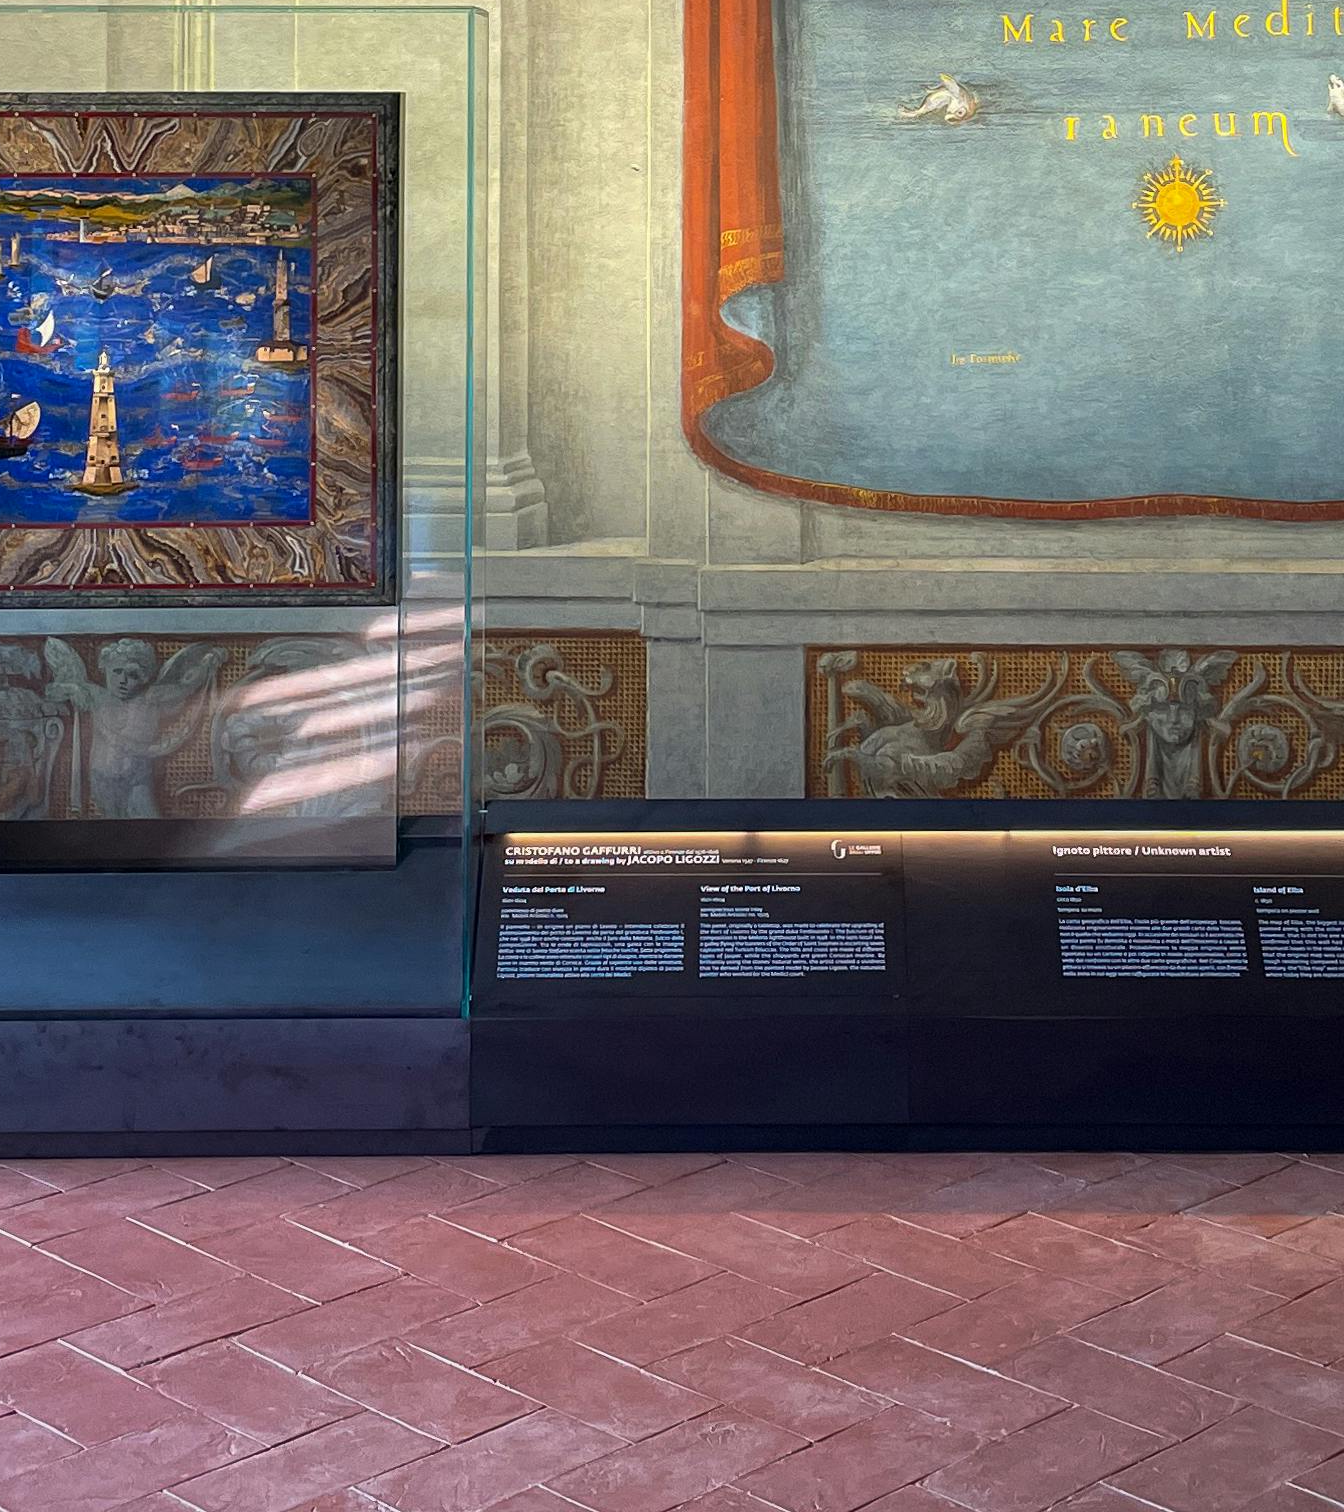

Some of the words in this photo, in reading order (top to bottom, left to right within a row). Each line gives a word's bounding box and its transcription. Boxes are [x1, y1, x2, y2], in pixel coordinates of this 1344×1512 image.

[1000, 13, 1129, 45] Mare
[505, 846, 581, 856] CRISTOFANO
[583, 846, 642, 856] GAFFURRI
[1052, 845, 1090, 857] Ignoto
[1093, 845, 1132, 857] pittore
[1142, 846, 1196, 856] Unknown
[1198, 846, 1231, 856] artist
[582, 857, 615, 866] drawing
[616, 857, 627, 866] by
[627, 855, 673, 866] JACOPO
[675, 854, 720, 865] LIGOZZI
[721, 885, 729, 893] of
[763, 885, 771, 893] of
[1278, 887, 1286, 896] of
